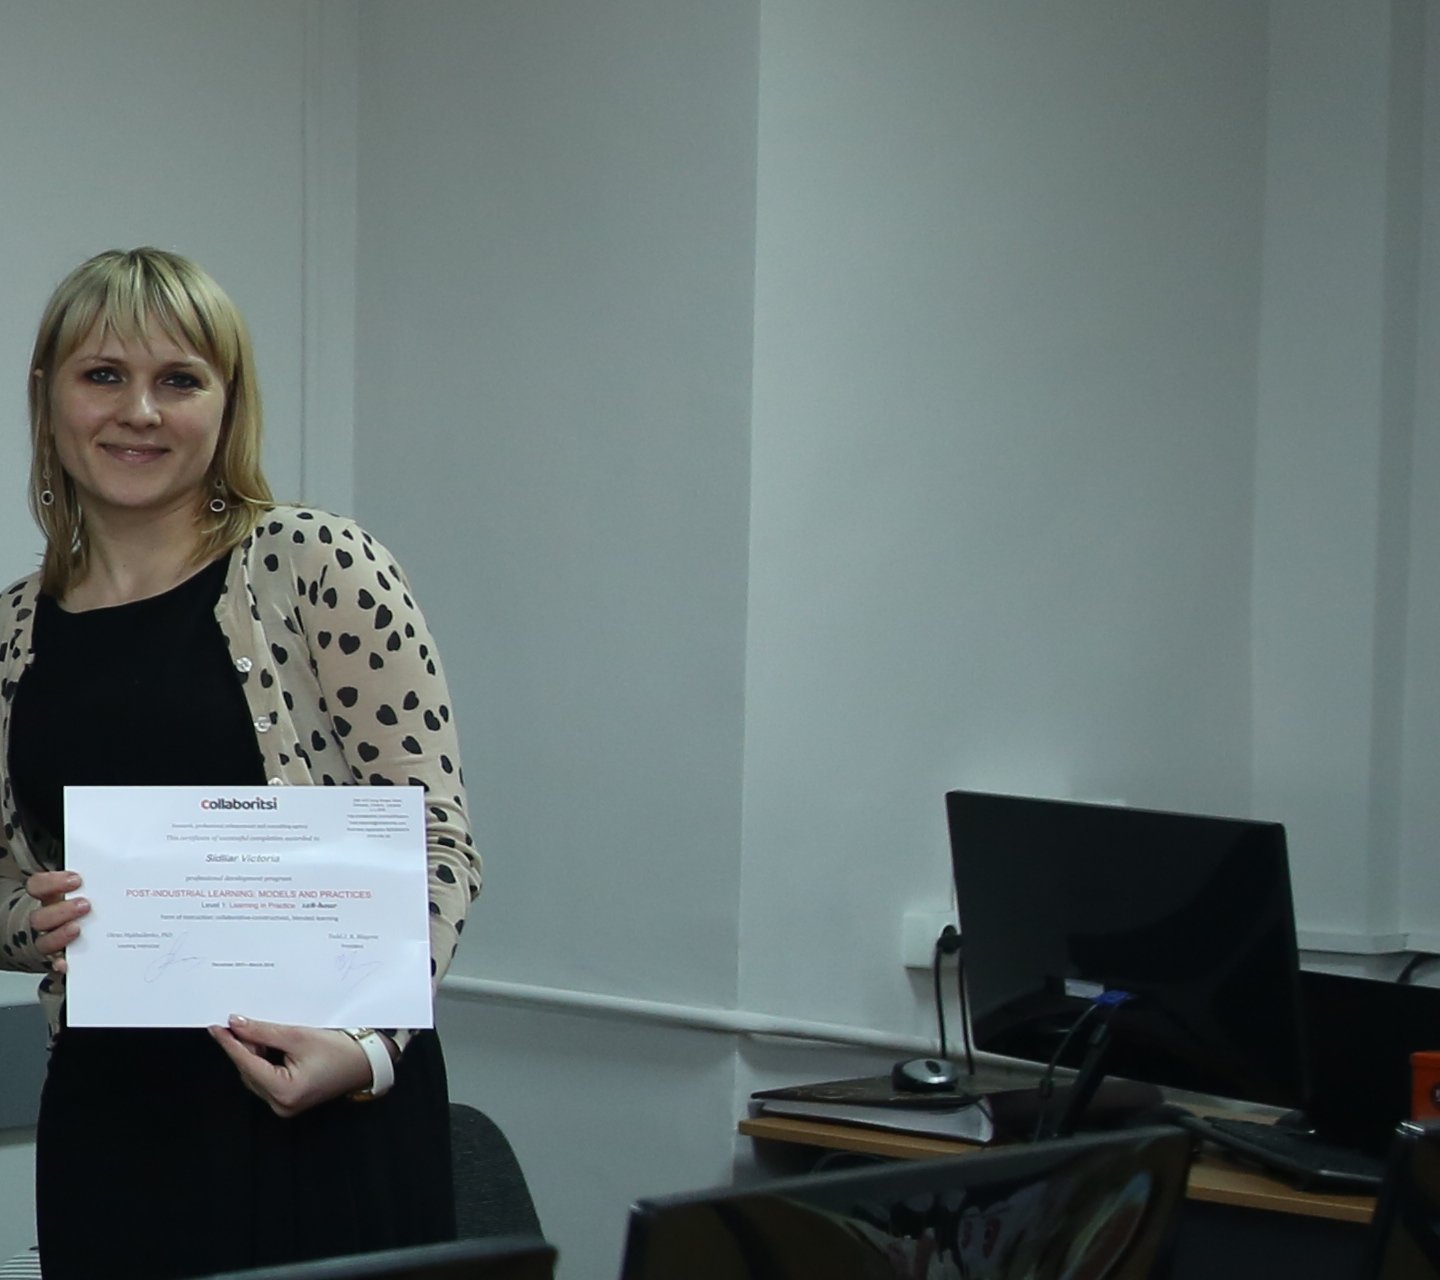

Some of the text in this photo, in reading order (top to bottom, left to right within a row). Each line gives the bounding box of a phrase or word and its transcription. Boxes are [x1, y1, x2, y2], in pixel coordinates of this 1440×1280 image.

[257, 889, 295, 897] MODELS
[297, 889, 317, 897] AND
[319, 889, 372, 898] PRACTICES
